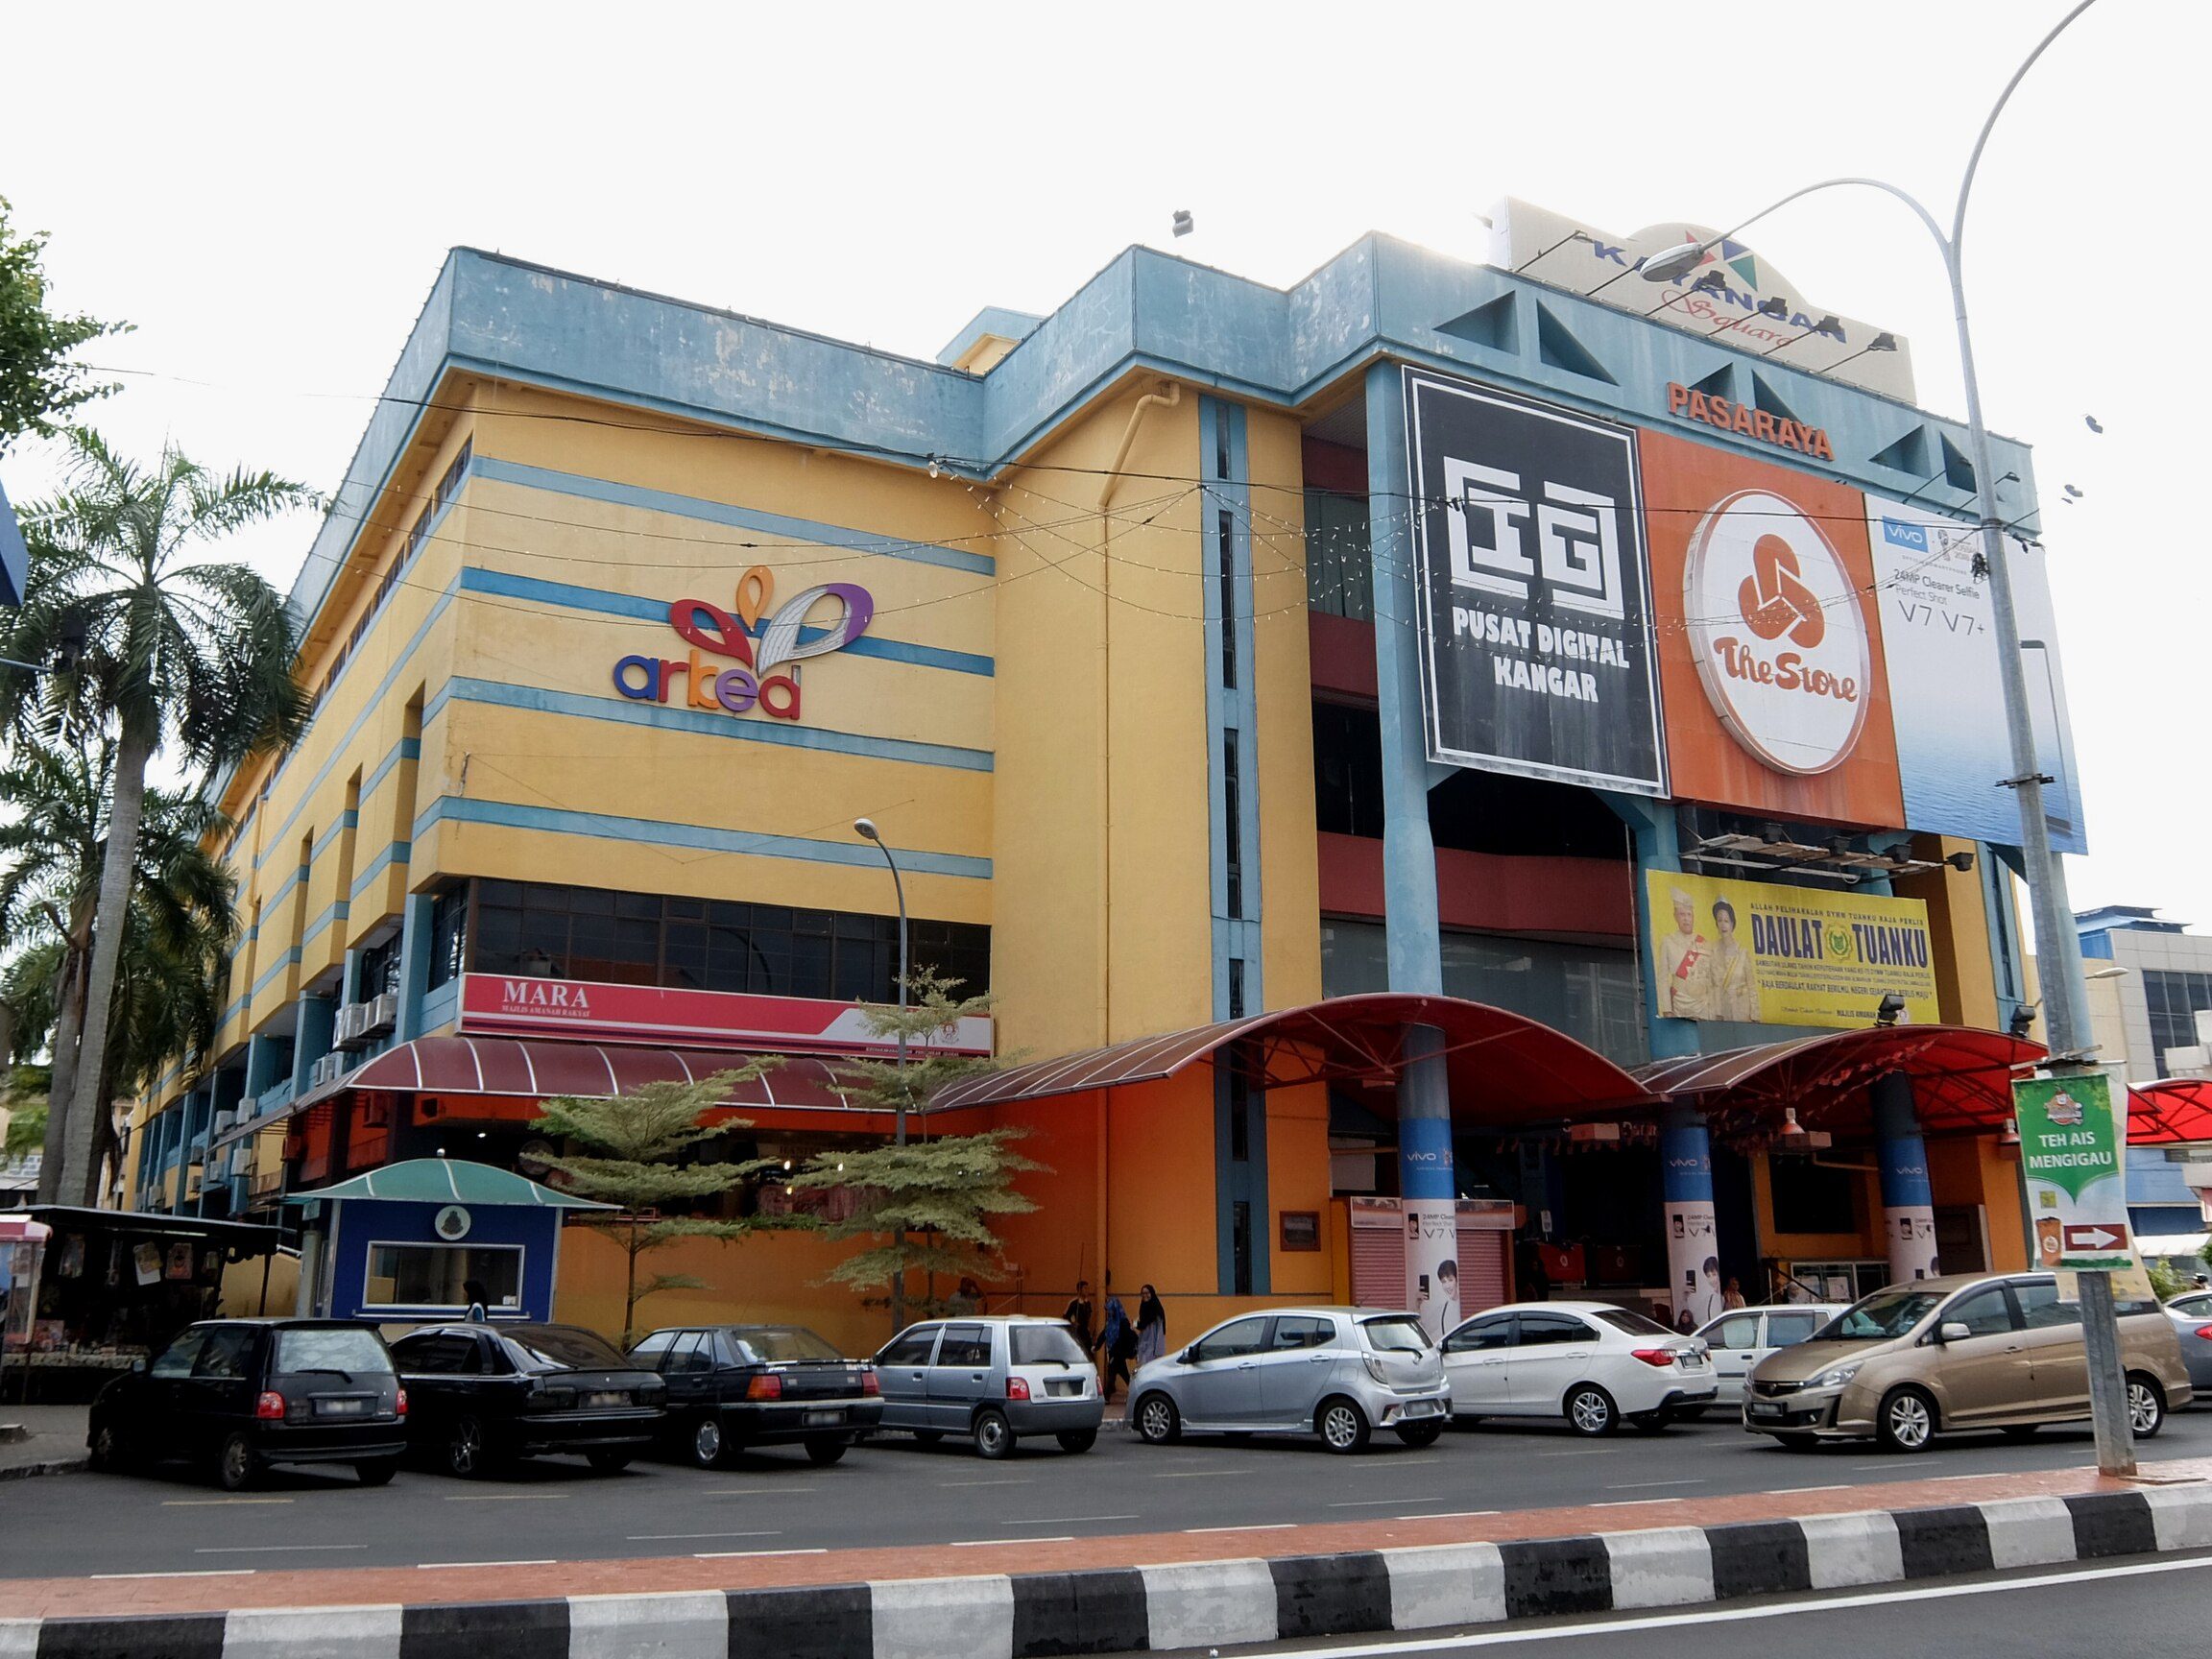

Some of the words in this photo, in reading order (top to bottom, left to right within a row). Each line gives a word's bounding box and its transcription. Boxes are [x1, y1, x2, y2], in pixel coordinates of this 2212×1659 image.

[1662, 289, 1791, 347] Square
[1666, 381, 1835, 461] PASARAYA
[1887, 524, 1923, 543] vivo
[1895, 583, 1927, 601] Perfect
[1928, 591, 1948, 606] Shot
[1922, 575, 1954, 592] Clearer
[1955, 584, 1981, 600] Selfie
[1899, 600, 1932, 626] V7
[1942, 610, 1985, 636] V7+
[1453, 607, 1531, 649] PUSAT
[1537, 624, 1630, 669] DIGITAL
[1494, 656, 1599, 703] KANGAR
[1750, 902, 1773, 912] ALLAH
[1751, 913, 1823, 959] DAULAT
[1851, 923, 1929, 969] TUANKU
[502, 980, 589, 1008] MARA
[2037, 1134, 2067, 1147] TEH
[2070, 1131, 2096, 1145] AIS
[1407, 1151, 1436, 1162] vivo
[2030, 1151, 2112, 1168] MENGIGAU
[1423, 1228, 1445, 1238] V7
